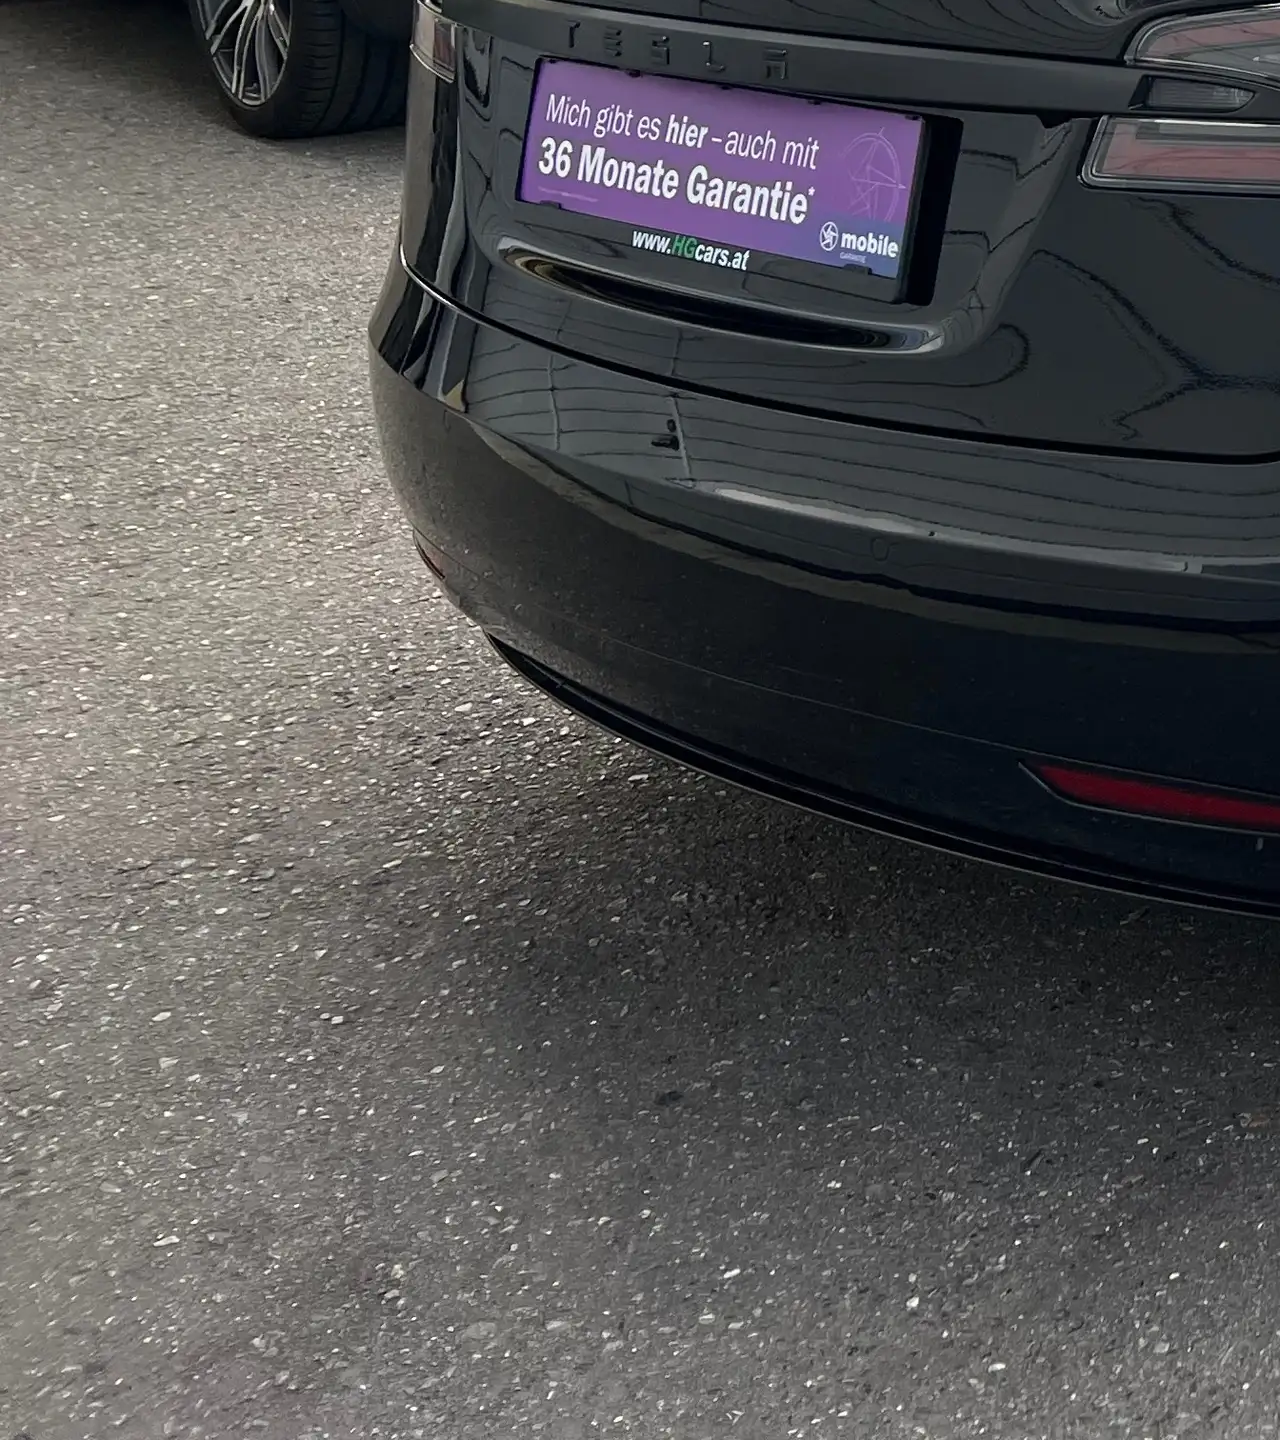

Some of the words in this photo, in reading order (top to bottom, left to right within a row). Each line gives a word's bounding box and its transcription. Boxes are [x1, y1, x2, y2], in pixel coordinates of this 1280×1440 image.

[565, 18, 791, 81] TESLA
[546, 93, 591, 128] Mich
[593, 104, 634, 138] gibt
[637, 115, 662, 141] es
[665, 114, 709, 148] hier
[724, 130, 777, 162] auch
[782, 137, 820, 170] mit
[538, 136, 573, 178] 36
[577, 144, 679, 199] Monate
[632, 230, 750, 270] www.HGcars.at
[840, 232, 899, 258] mobile
